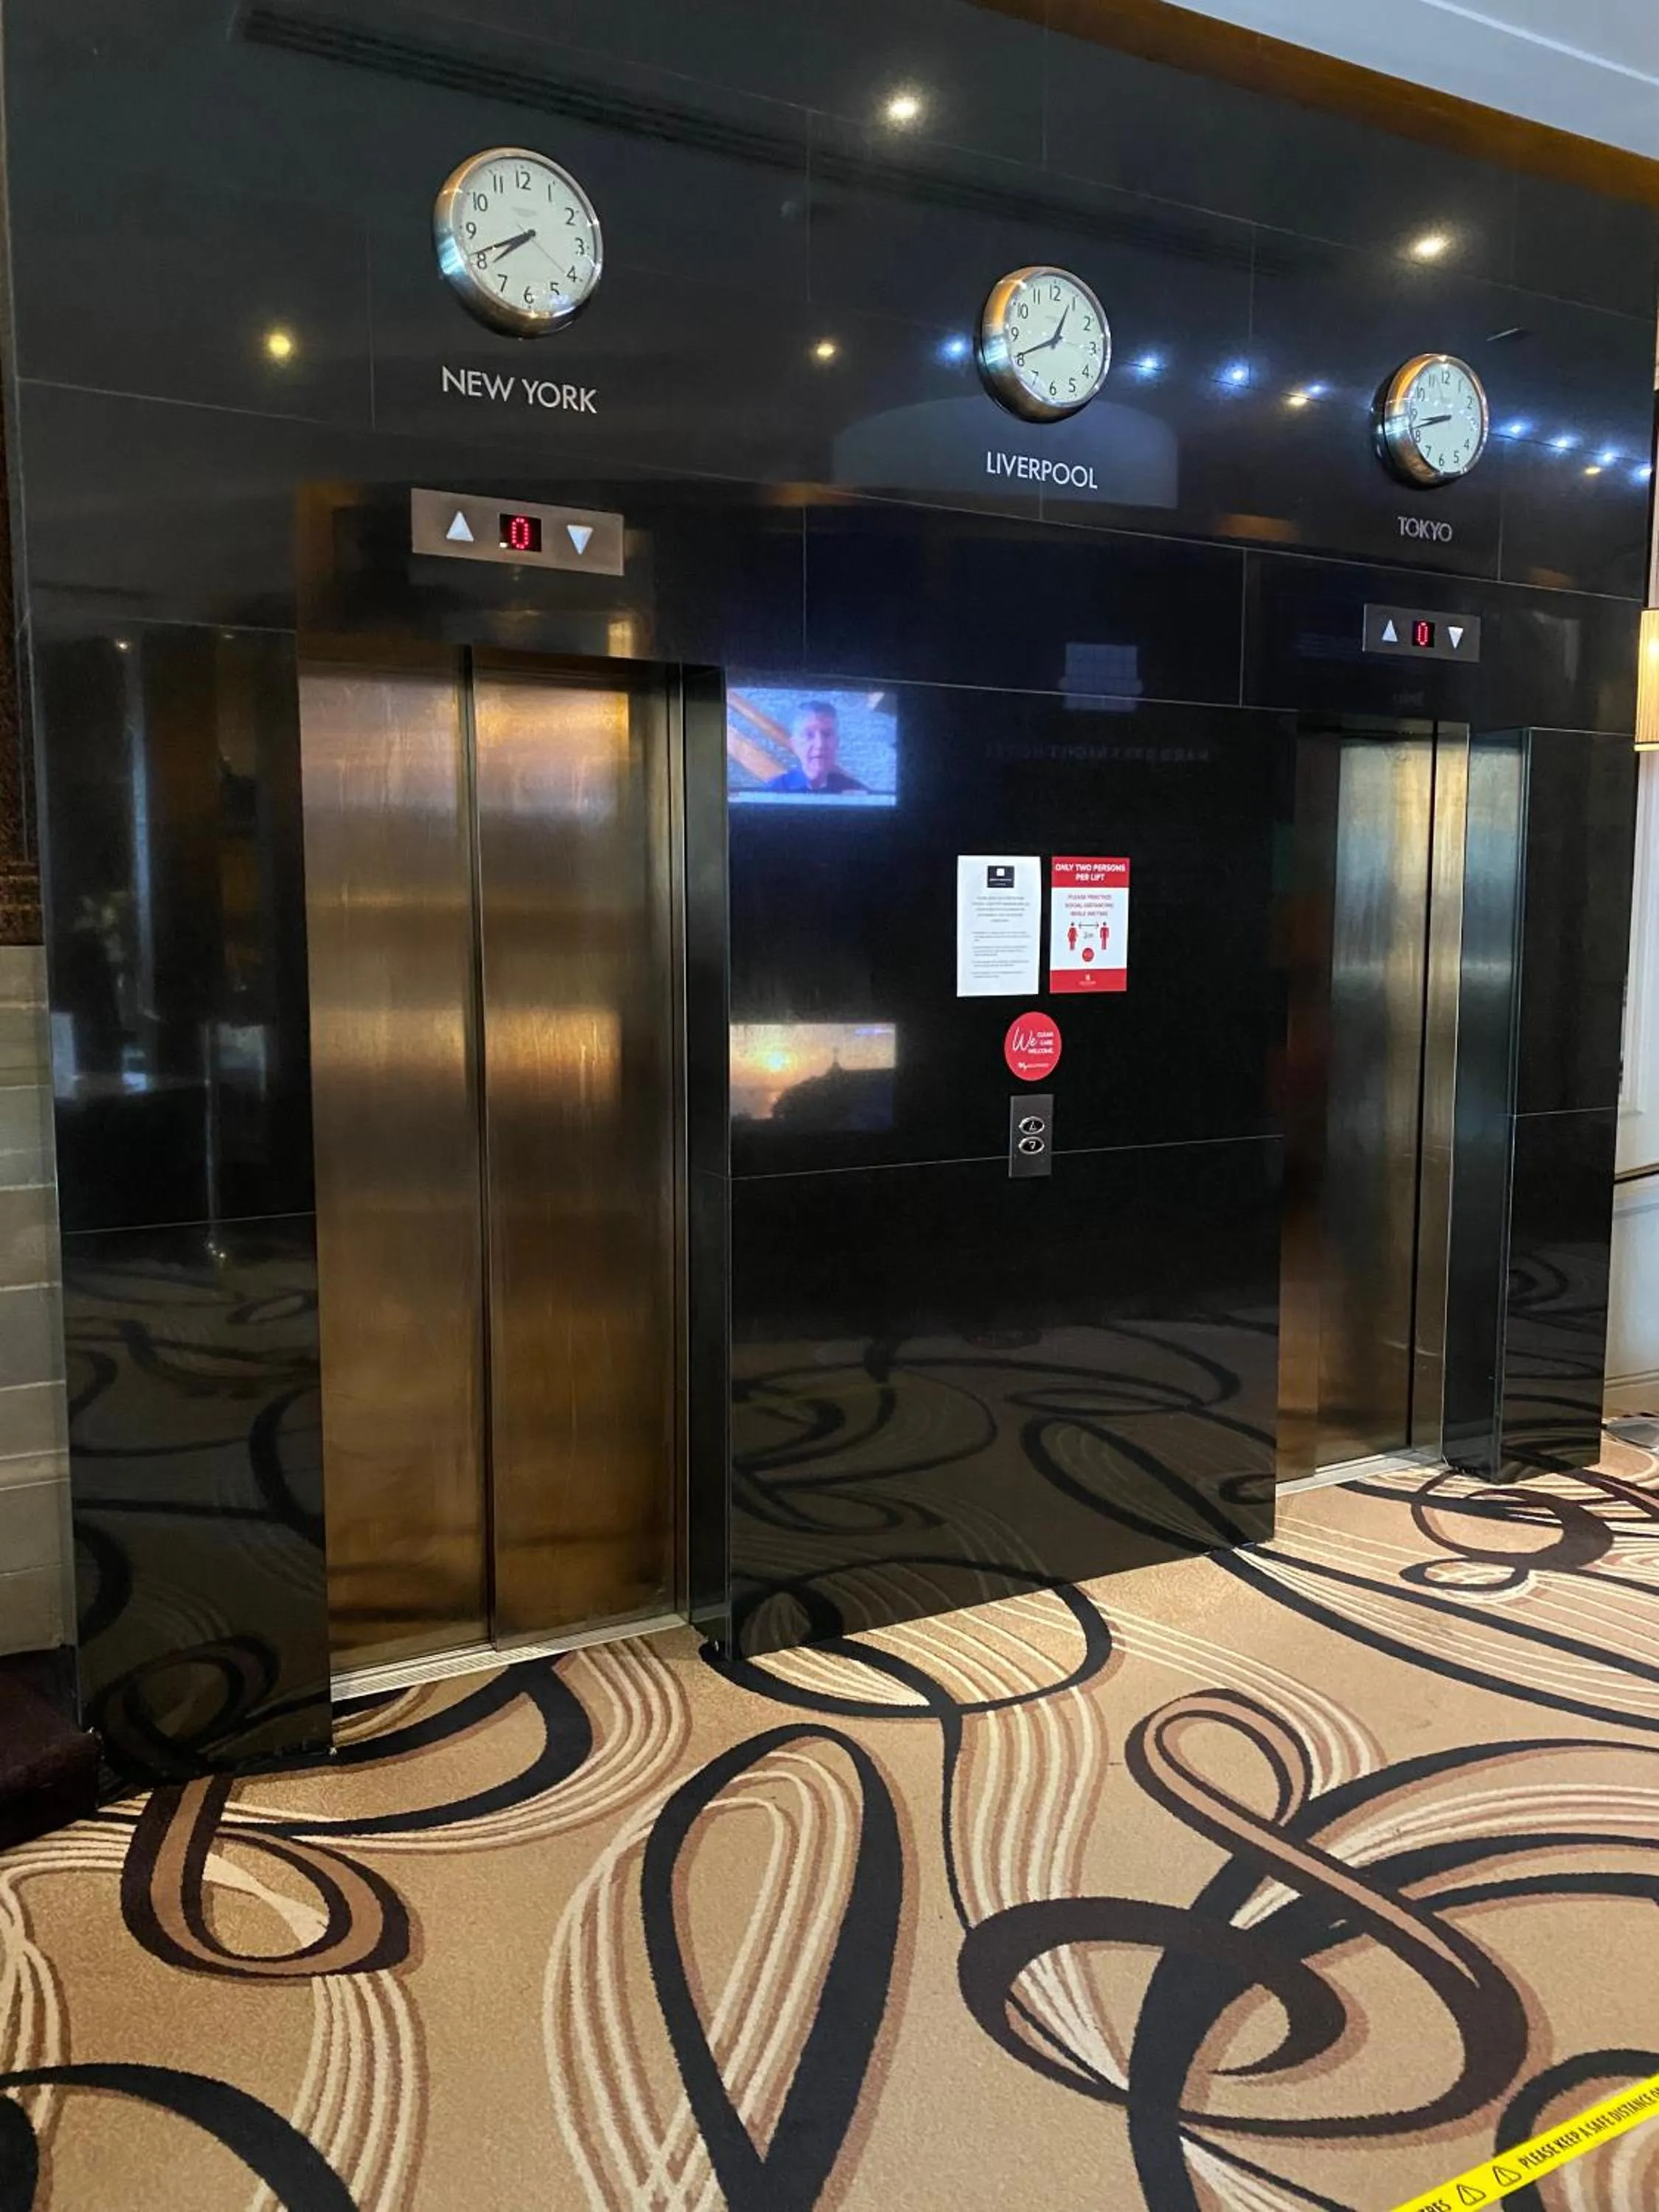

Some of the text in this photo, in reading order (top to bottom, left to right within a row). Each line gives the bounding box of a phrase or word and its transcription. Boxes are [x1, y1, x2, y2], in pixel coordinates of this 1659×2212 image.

[493, 175, 504, 194] 11
[516, 171, 532, 191] 12
[473, 192, 488, 212] 10
[548, 184, 553, 203] 1
[564, 207, 575, 226] 2
[466, 222, 477, 240] 9
[575, 237, 585, 256] 3
[498, 274, 508, 293] 7
[566, 265, 577, 283] 4
[523, 286, 535, 305] 6
[1034, 288, 1041, 305] 11
[1049, 285, 1062, 302] 12
[1017, 303, 1029, 319] 10
[1072, 297, 1076, 311] 1
[1083, 316, 1091, 331] 2
[1011, 327, 1020, 342] 9
[1088, 341, 1097, 357] 3
[1032, 370, 1039, 386] 7
[1081, 364, 1090, 379] 4
[442, 366, 597, 414] NEW YORK
[1049, 380, 1057, 396] 6
[1068, 378, 1077, 393] 5
[987, 451, 1098, 489] LIVERPOOL
[511, 516, 529, 550] 0
[1398, 516, 1453, 542] TOKYO
[1417, 621, 1428, 645] 0
[1055, 863, 1126, 872] ONLY TWO PERSONS
[1075, 873, 1105, 881] PER LIFT
[1607, 2093, 1658, 2122] DISTANCE
[1578, 2126, 1593, 2138] A
[1585, 2115, 1616, 2134] SAFE
[1553, 2130, 1582, 2150] KEEP
[1518, 2143, 1561, 2170] PLEASE
